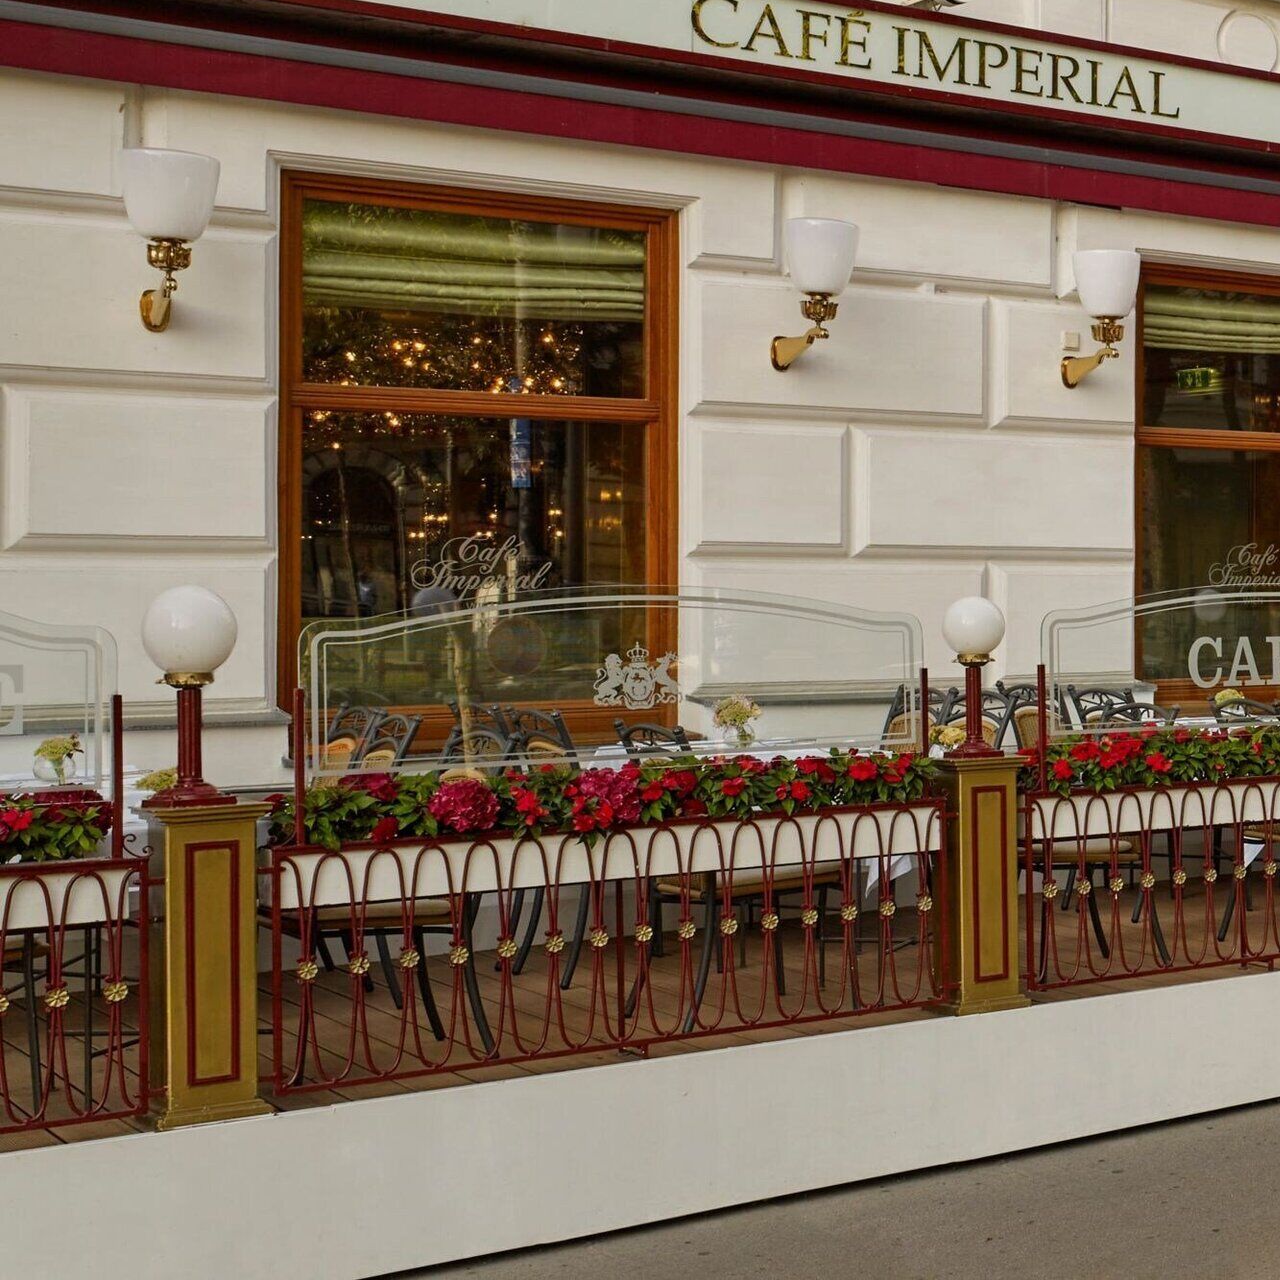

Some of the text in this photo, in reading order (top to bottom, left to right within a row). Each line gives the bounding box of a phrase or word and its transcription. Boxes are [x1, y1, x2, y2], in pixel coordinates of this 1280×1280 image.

[891, 25, 1180, 120] IMPERIAL
[440, 534, 525, 575] Café
[1226, 542, 1280, 575] Café
[411, 558, 553, 602] Imperial
